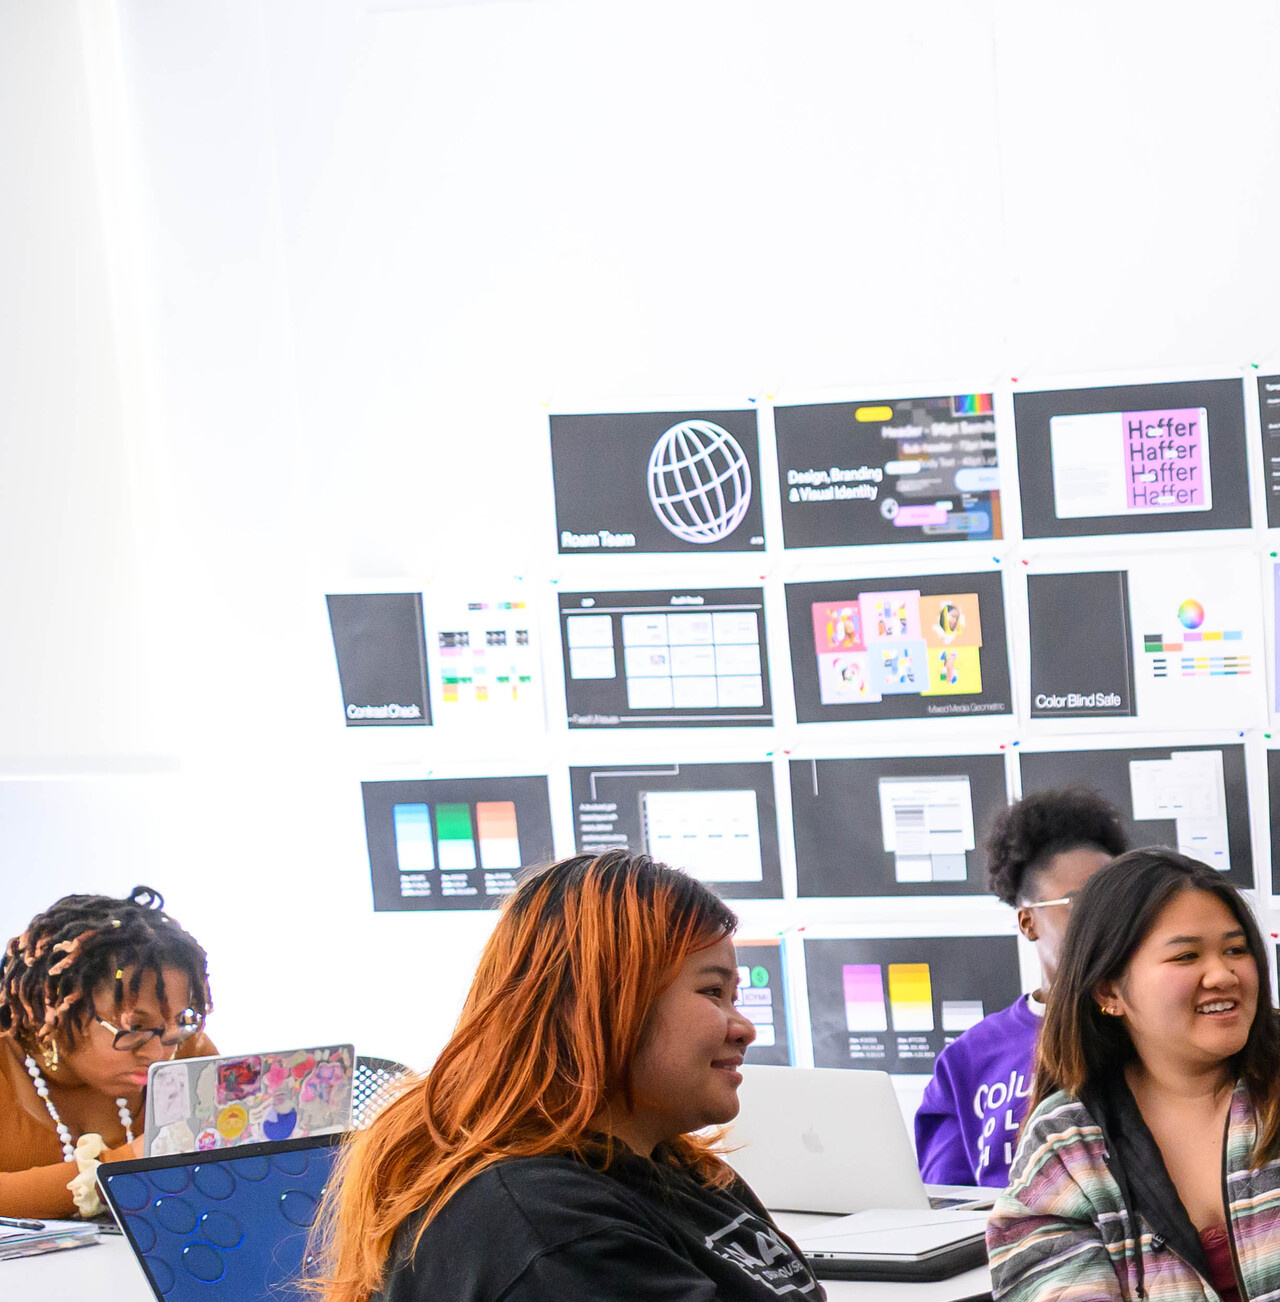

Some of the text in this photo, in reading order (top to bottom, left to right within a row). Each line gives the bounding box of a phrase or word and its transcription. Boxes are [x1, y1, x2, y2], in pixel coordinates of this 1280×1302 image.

[1130, 440, 1197, 461] Haffer
[788, 467, 883, 485] Design, Branding
[1132, 462, 1197, 483] Haffer
[561, 530, 635, 547] Roam Team
[1035, 693, 1121, 708] Color Blind Safe
